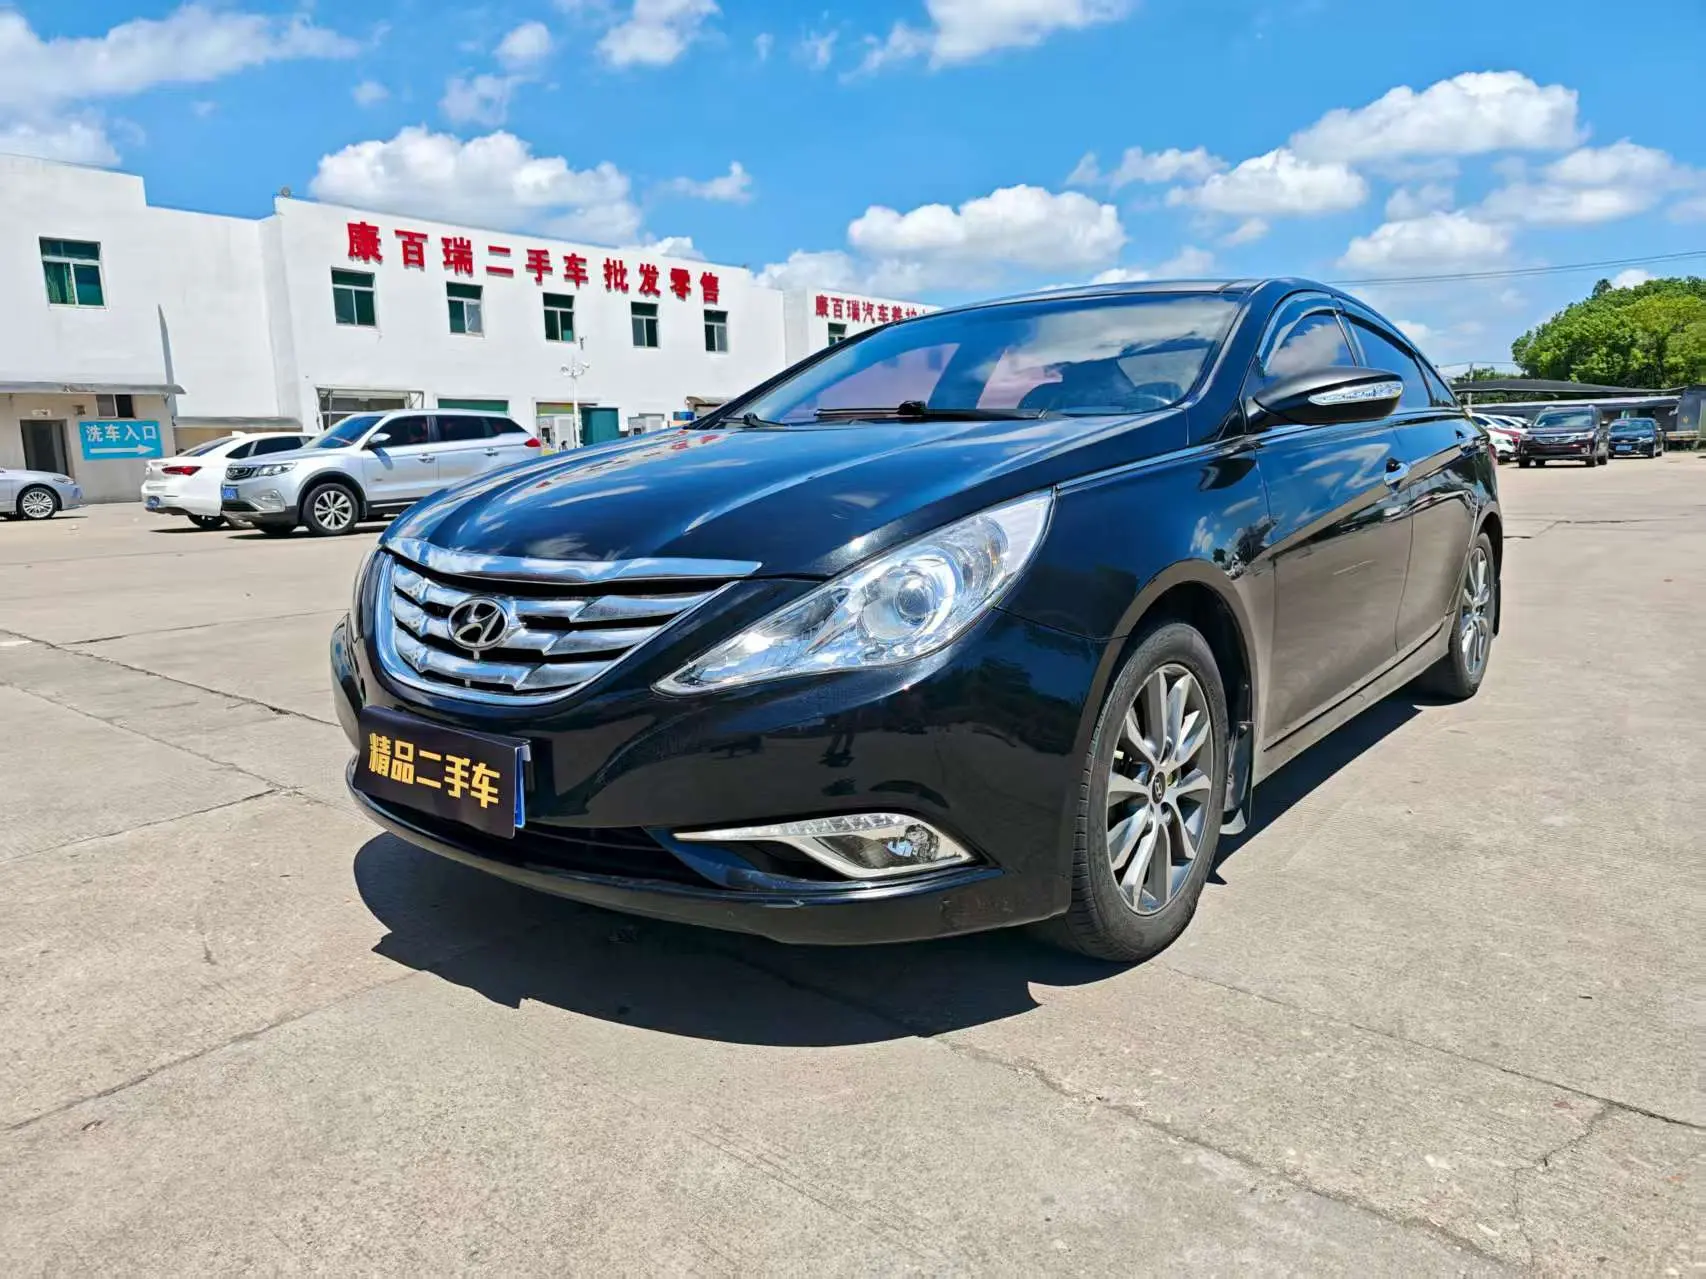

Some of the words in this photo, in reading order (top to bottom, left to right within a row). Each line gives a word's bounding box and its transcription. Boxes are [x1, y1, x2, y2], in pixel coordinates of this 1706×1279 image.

[347, 221, 720, 304] 康百瑞二手车批发零售
[85, 424, 157, 442] 洗车入口
[368, 732, 500, 809] 精品二手车
